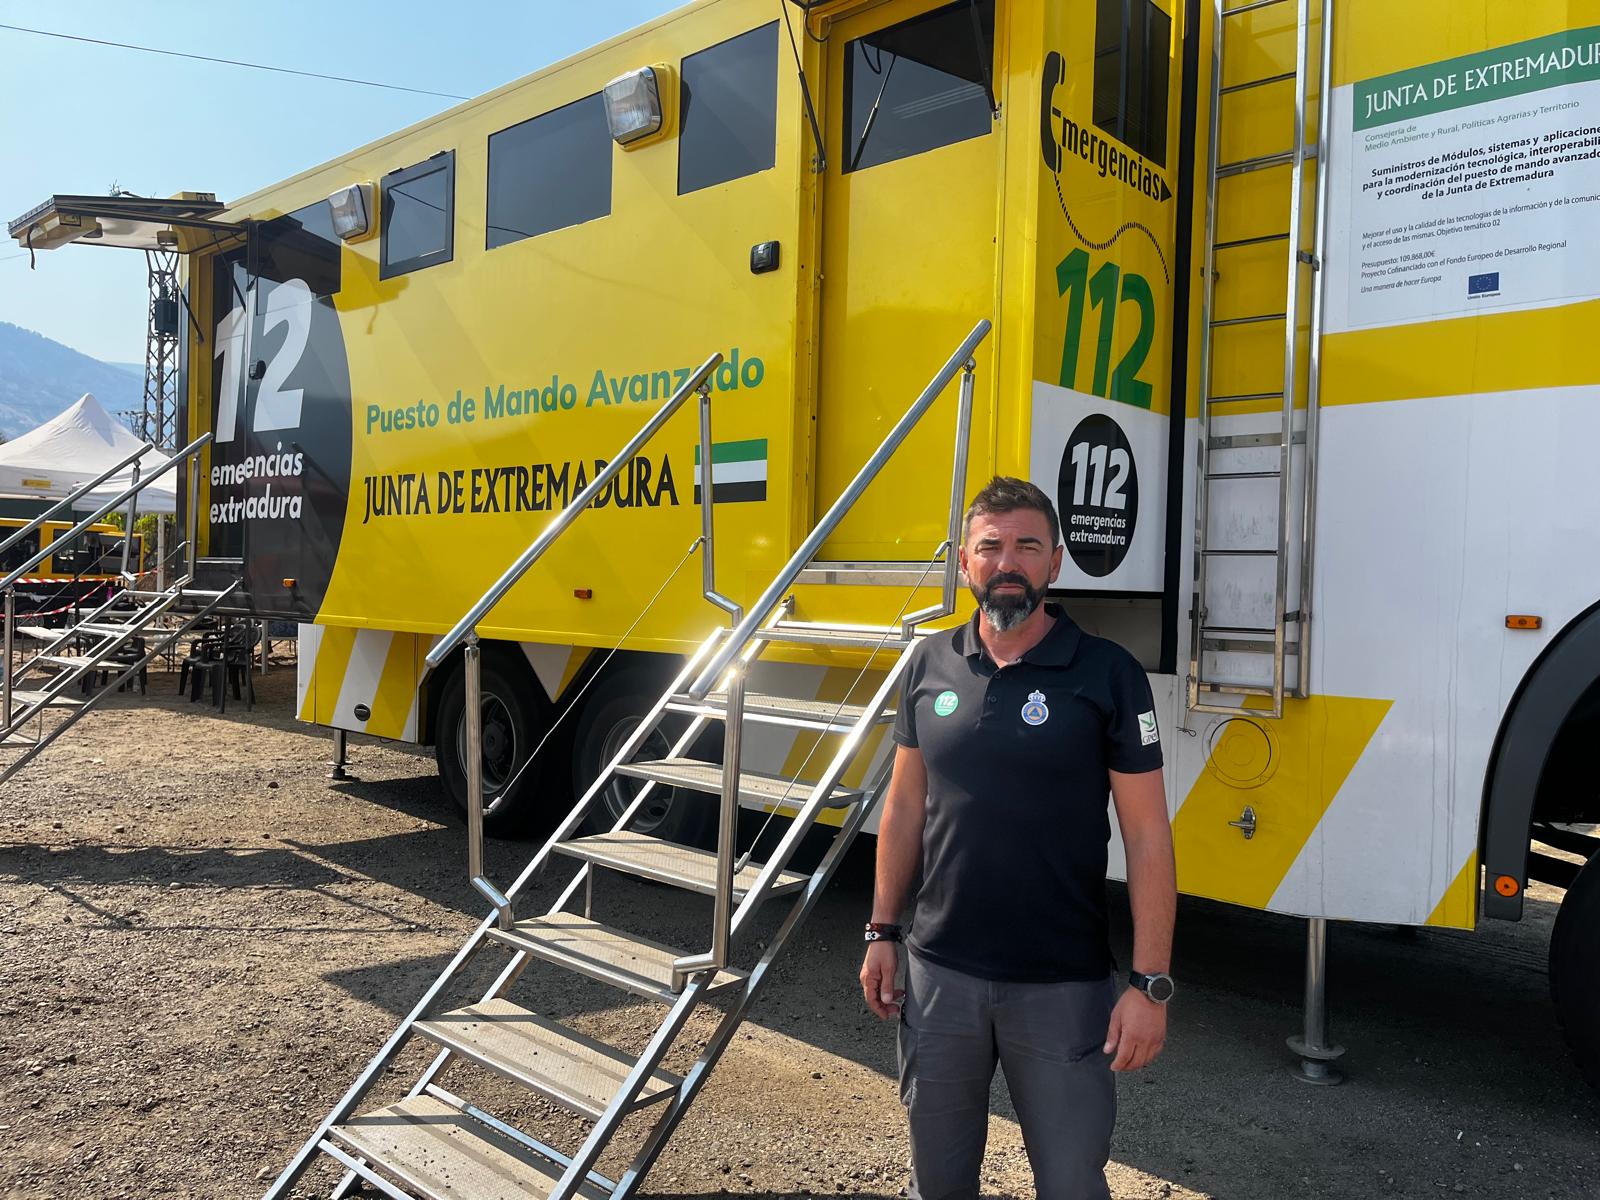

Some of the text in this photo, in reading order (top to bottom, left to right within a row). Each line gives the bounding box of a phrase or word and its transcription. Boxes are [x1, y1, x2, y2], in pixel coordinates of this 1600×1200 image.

[1366, 83, 1428, 119] JUNTA
[1433, 74, 1457, 98] DE
[1364, 141, 1389, 152] Medio
[1391, 132, 1429, 145] Ambiente
[1437, 125, 1460, 135] Rural,
[1496, 110, 1531, 124] Agrarias
[1532, 109, 1538, 117] y
[1540, 100, 1580, 114] Territorio
[1407, 125, 1417, 133] de
[1362, 180, 1383, 192] para
[1385, 177, 1393, 186] la
[1395, 162, 1465, 184] modernización
[1467, 151, 1527, 169] tecnológica,
[1371, 160, 1426, 177] Suministros
[1427, 156, 1440, 166] de
[1441, 147, 1486, 163] Módulos,
[1488, 137, 1531, 153] sistemas
[1532, 137, 1539, 146] y
[1377, 191, 1383, 200] y
[1384, 178, 1445, 197] coordinación
[1447, 173, 1462, 183] del
[1464, 168, 1498, 183] puesto
[1500, 164, 1512, 173] de
[1515, 157, 1550, 172] mando
[1421, 169, 1554, 200] de la Junta de Extremadura
[1362, 229, 1385, 240] Mejorar
[1392, 226, 1403, 234] uso
[1403, 226, 1408, 234] y
[1414, 219, 1437, 230] calidad
[1437, 218, 1446, 226] de
[1509, 201, 1548, 213] información
[1554, 198, 1563, 206] de
[1563, 197, 1570, 205] la
[1366, 241, 1372, 249] el
[1373, 239, 1392, 248] acceso
[1393, 236, 1401, 244] de
[1436, 226, 1463, 237] Objetivo
[1492, 219, 1501, 227] 02
[1361, 268, 1386, 279] Proyecto
[1387, 262, 1426, 275] Cofinanciado
[1427, 260, 1438, 268] con
[1446, 255, 1466, 265] Fondo
[1467, 253, 1494, 262] Europeo
[1504, 245, 1537, 256] Desarrollo
[1538, 240, 1567, 252] Regional
[1361, 257, 1398, 269] Presupuesto:
[1396, 280, 1403, 288] de
[1420, 275, 1442, 284] Europa
[1056, 247, 1155, 410] 112
[366, 347, 765, 435] Puesto de Mando Avanzdo
[362, 453, 680, 524] JUNTA DE EXTREMADURA
[1071, 442, 1130, 510] 112
[1069, 529, 1126, 546] extremadura
[1071, 513, 1126, 531] emergencias
[938, 695, 957, 706] 112
